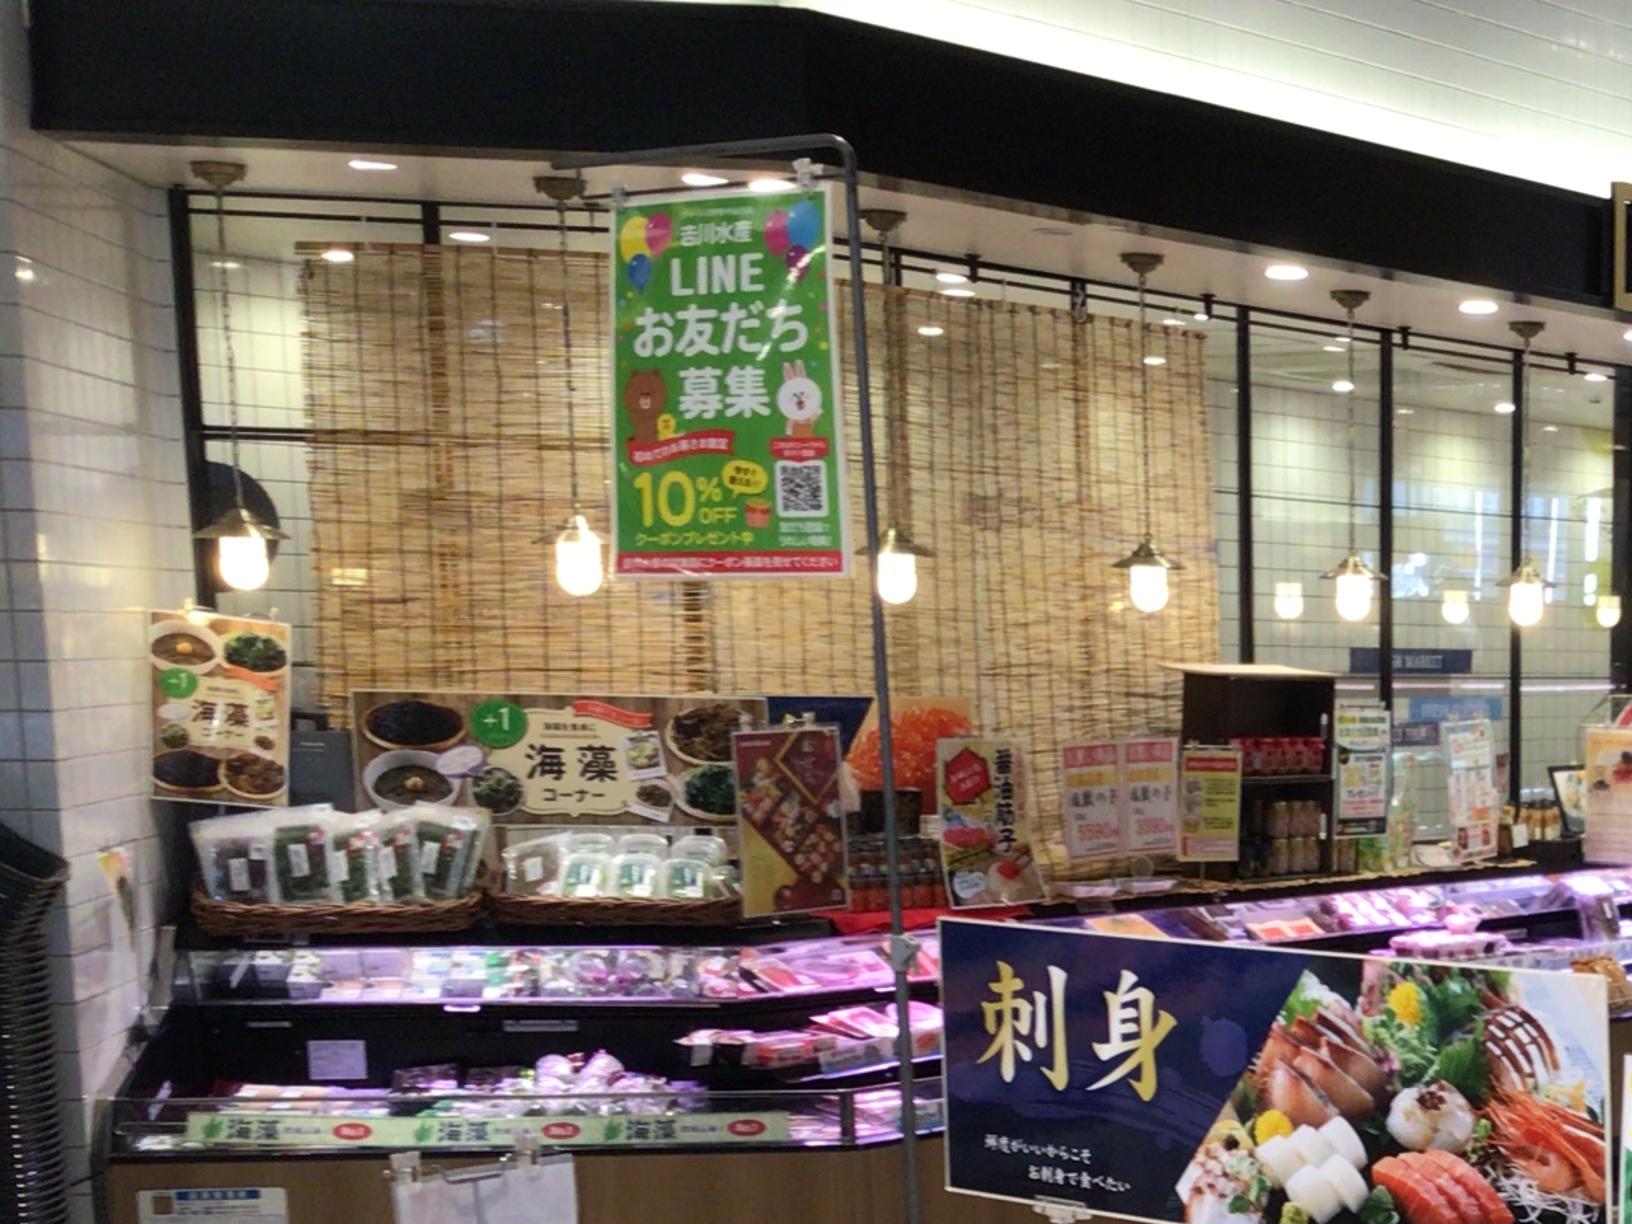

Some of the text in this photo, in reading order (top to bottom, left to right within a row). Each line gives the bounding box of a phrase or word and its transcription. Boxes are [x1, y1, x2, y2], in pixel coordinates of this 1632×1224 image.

[671, 252, 765, 296] LINE
[634, 299, 808, 357] お友だち
[679, 366, 771, 419] 募集
[699, 507, 738, 524] OFF
[525, 743, 618, 782] 海藻
[542, 788, 606, 802] コーナー
[976, 961, 1179, 1102] 刺身
